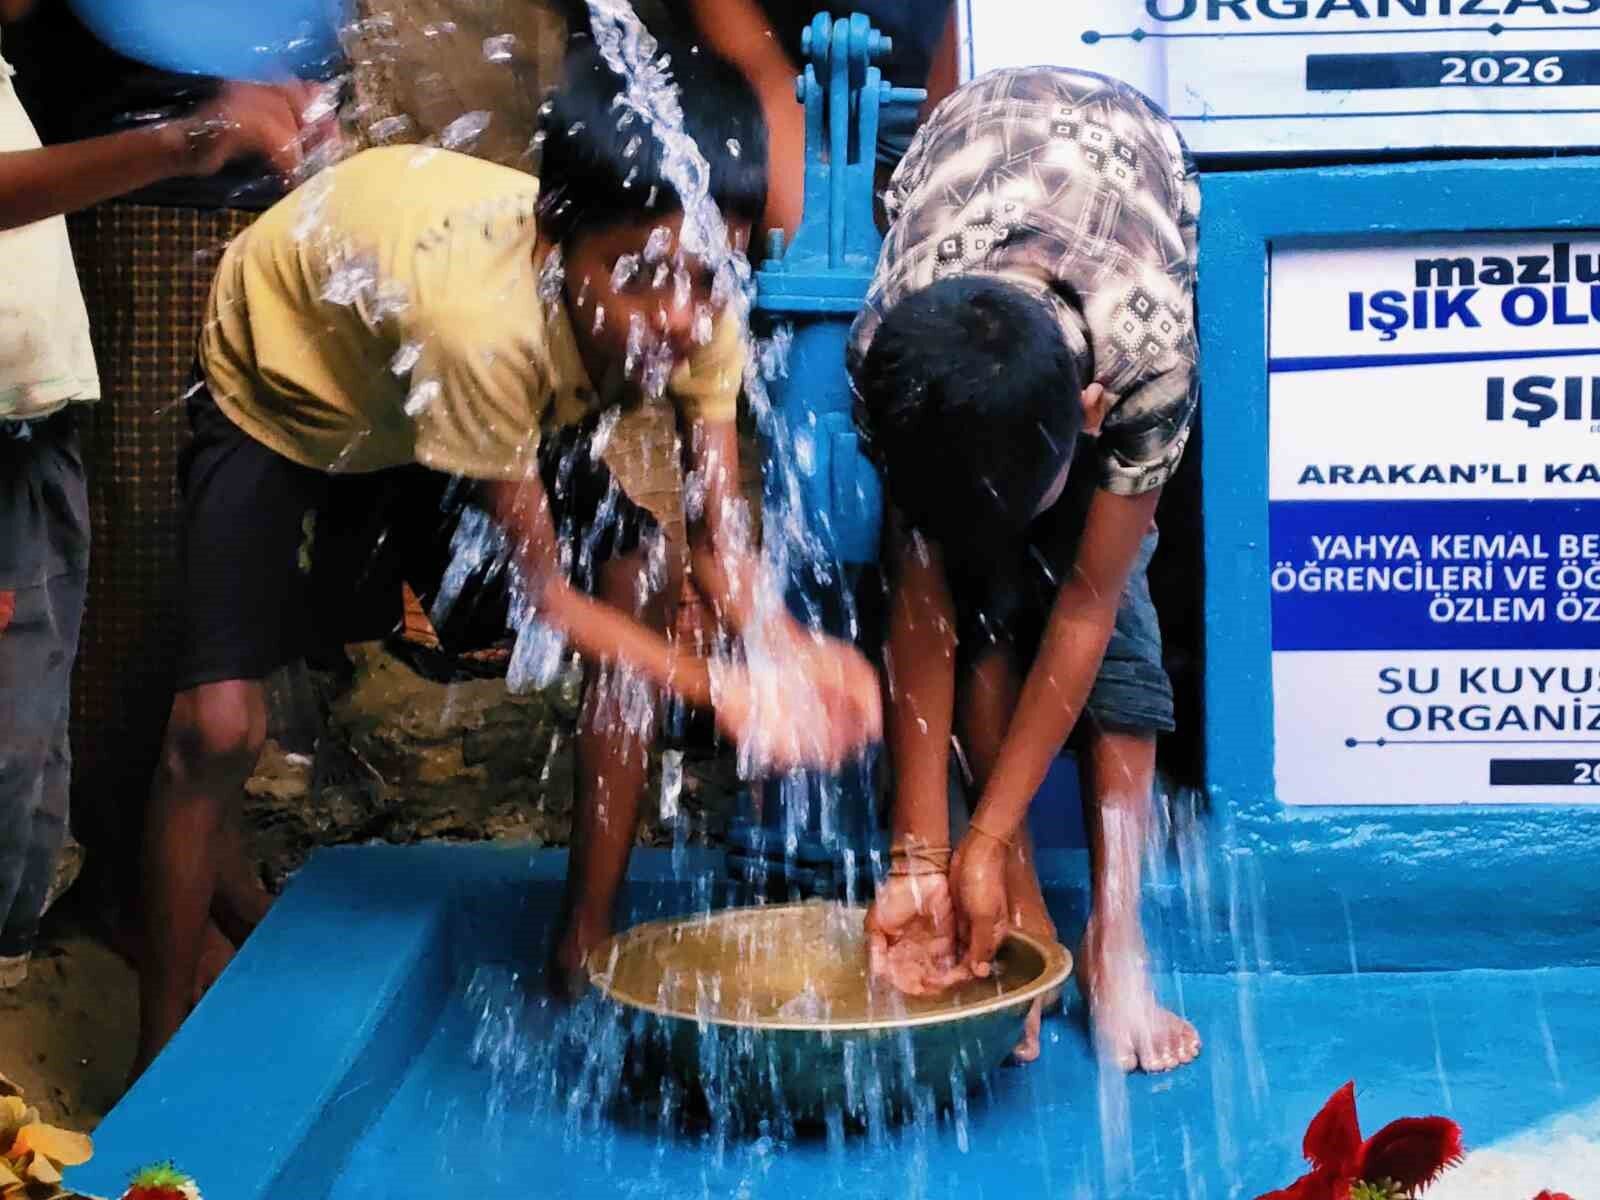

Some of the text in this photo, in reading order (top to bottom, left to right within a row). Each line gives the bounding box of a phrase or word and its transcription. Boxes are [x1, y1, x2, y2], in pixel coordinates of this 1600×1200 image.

[1440, 56, 1563, 84] 2026
[1415, 243, 1600, 287] mazlu
[1349, 286, 1600, 341] IŞIK OL
[1298, 463, 1600, 484] ARAKAN'LI KA
[1312, 534, 1600, 560] YAHYA KEMAL BE
[1271, 560, 1600, 592] ÖĞRENCİLERİ VE ÖĞ
[1429, 592, 1600, 622] ÖZLEM ÖZ
[1378, 667, 1600, 694] SU KUYU
